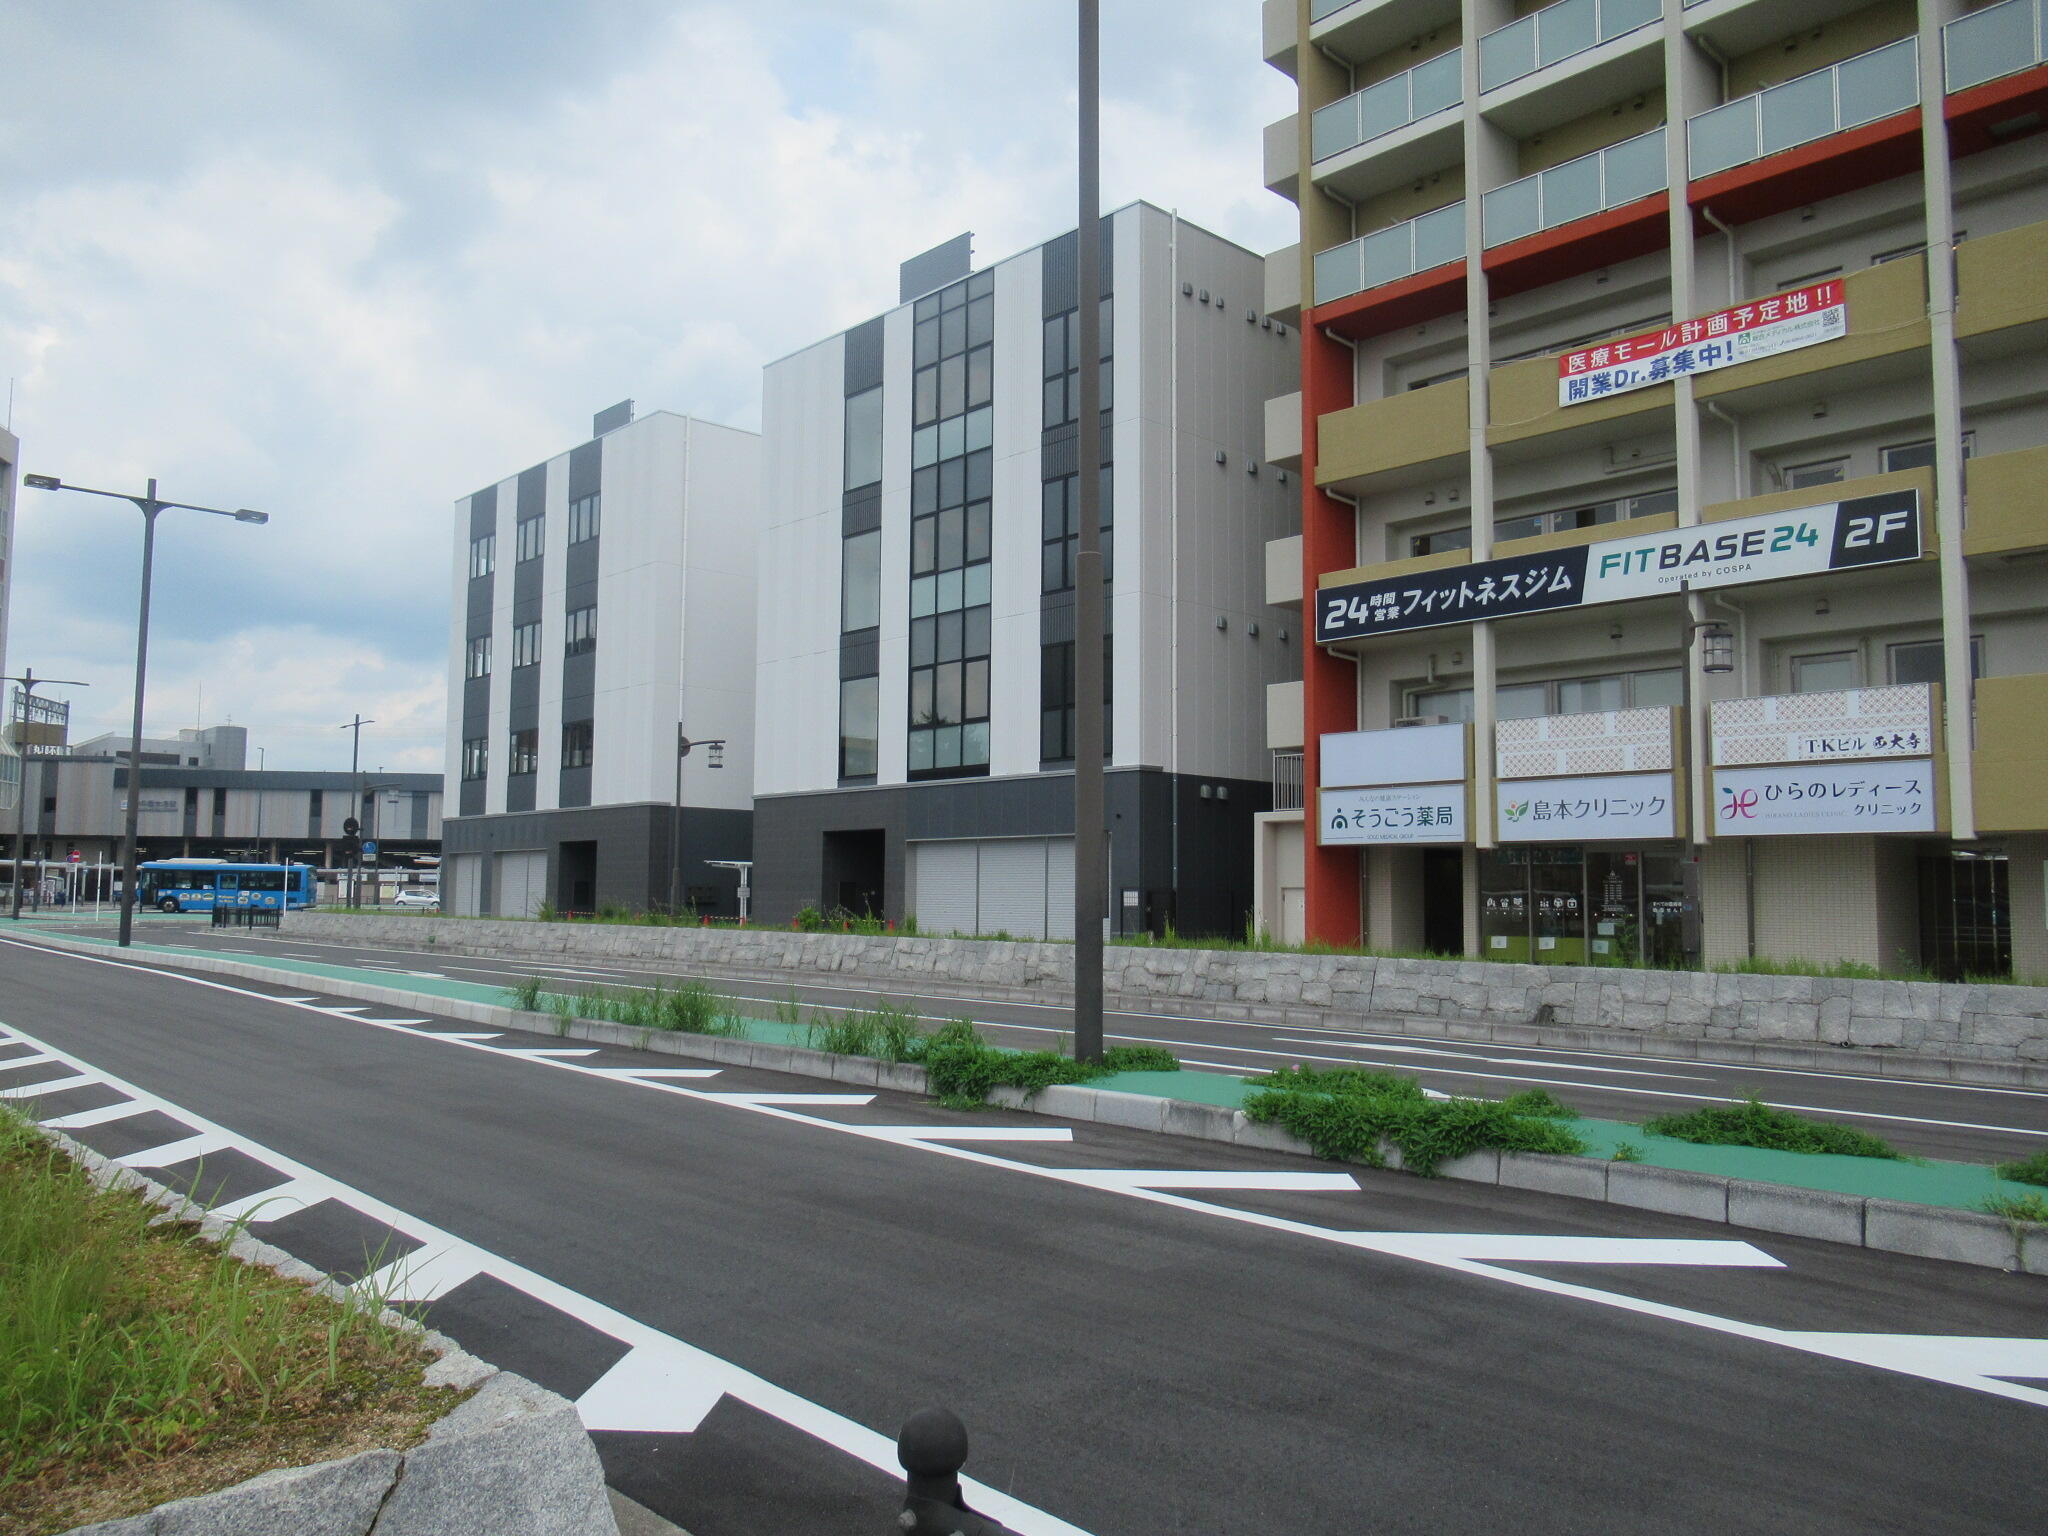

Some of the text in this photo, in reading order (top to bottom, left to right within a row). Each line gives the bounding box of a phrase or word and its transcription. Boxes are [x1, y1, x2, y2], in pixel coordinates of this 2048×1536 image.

[1568, 340, 1734, 401] 開業Dr.募集中!
[1844, 510, 1908, 549] 2F
[1658, 572, 1698, 584] Operated
[1716, 564, 1752, 575] COSPA
[1402, 566, 1572, 615] フィットネスジム
[1765, 779, 1922, 801] ひらのレディース
[1351, 806, 1453, 829] そうごう薬局
[1533, 796, 1665, 821] 島本クリニック
[1854, 802, 1921, 817] クリニック
